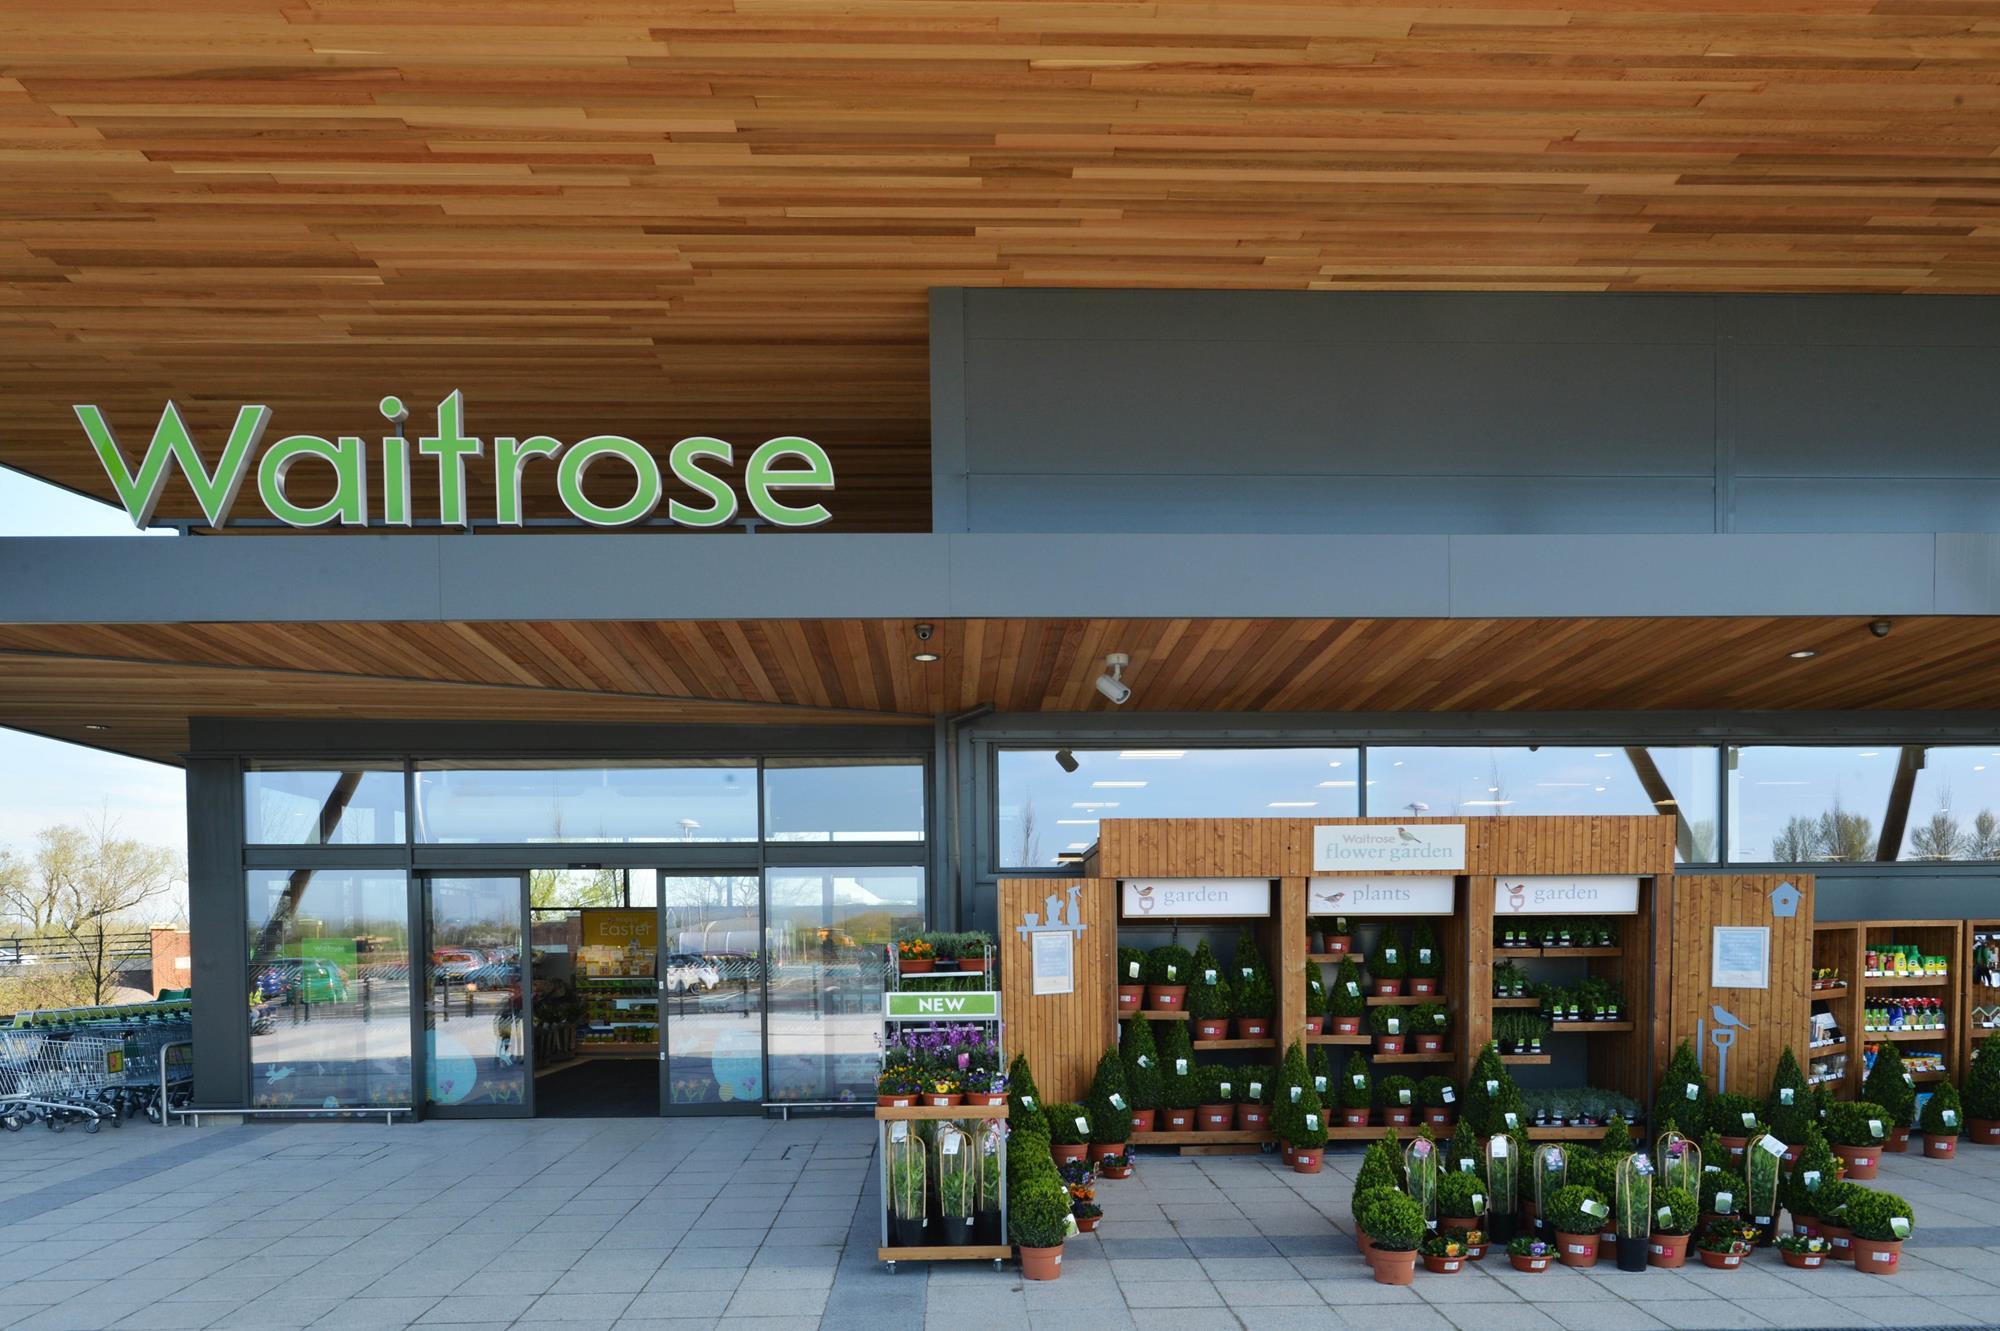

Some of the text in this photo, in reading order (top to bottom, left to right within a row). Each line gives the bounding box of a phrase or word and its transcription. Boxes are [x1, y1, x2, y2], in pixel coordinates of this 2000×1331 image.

[72, 388, 836, 531] Waitrose
[1342, 834, 1396, 845] Waitrose
[1326, 842, 1453, 862] flower garden
[1164, 885, 1229, 906] garden
[1353, 884, 1411, 905] plants
[1534, 883, 1598, 904] garden
[600, 922, 653, 936] Easter
[919, 997, 965, 1013] NEW
